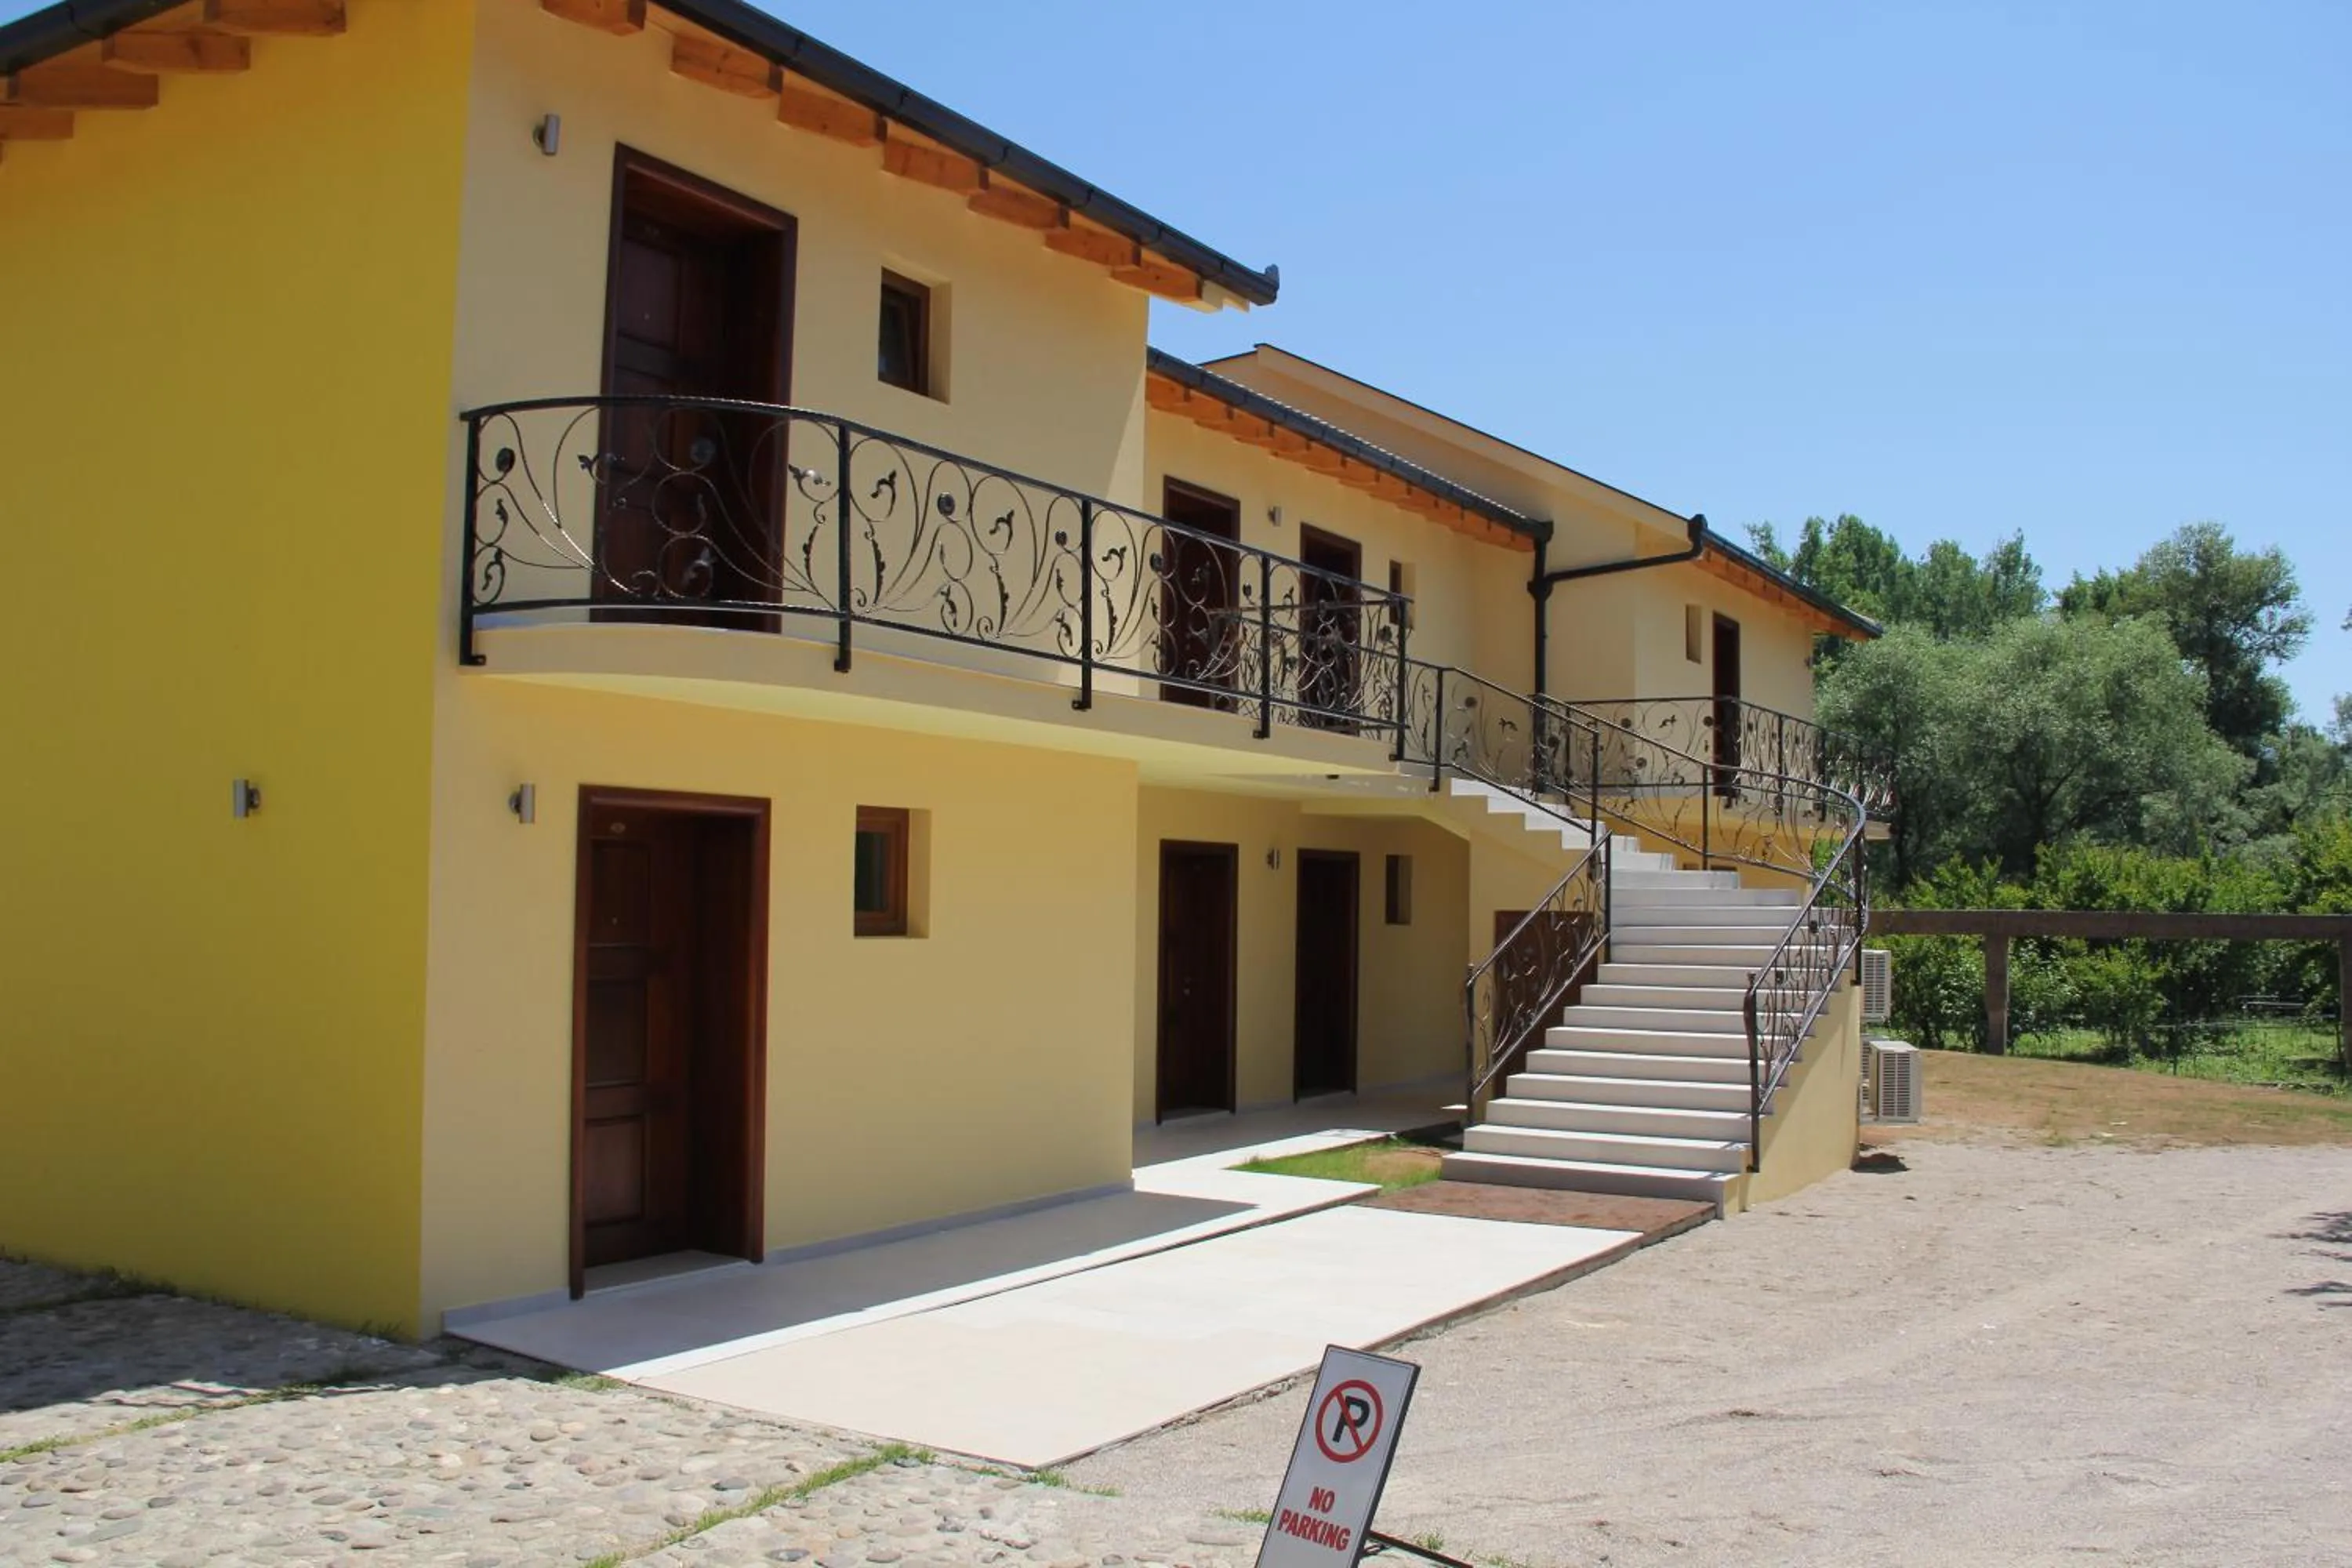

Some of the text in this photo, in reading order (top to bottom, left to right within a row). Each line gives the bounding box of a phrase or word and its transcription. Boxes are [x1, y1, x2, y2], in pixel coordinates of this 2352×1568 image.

[1332, 1396, 1370, 1443] P
[1308, 1486, 1335, 1513] NO
[1278, 1508, 1351, 1551] PARKING
